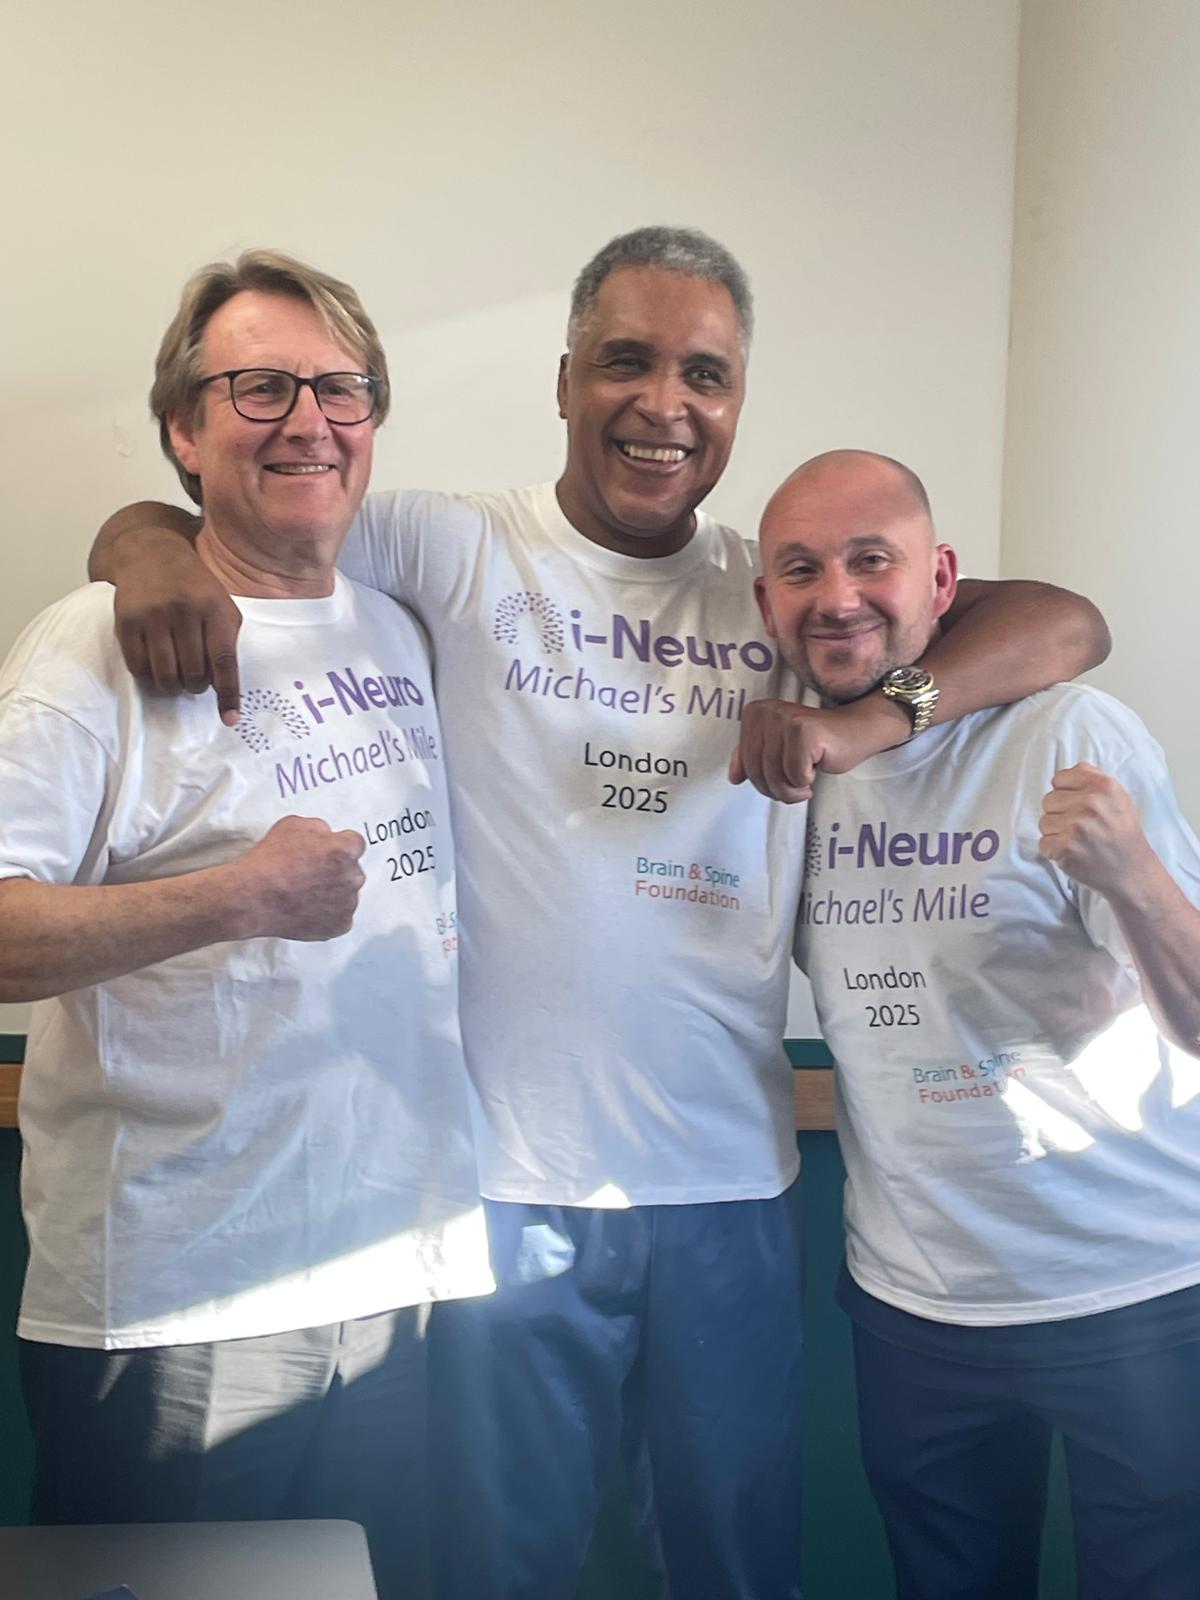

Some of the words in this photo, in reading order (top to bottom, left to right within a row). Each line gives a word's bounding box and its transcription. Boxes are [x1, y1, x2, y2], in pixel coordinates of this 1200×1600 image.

[570, 609, 774, 673] i-Neuro
[294, 667, 424, 724] i-Neuro
[504, 658, 676, 715] Michael's
[687, 684, 746, 721] Mil
[275, 729, 405, 799] Michael's
[584, 742, 688, 778] London
[601, 784, 668, 814] 2025
[364, 807, 436, 845] London
[828, 821, 1000, 869] i-Neuro
[636, 857, 684, 879] Brain
[688, 863, 702, 881] &
[703, 865, 740, 889] Spine
[635, 880, 740, 911] Foundation
[798, 888, 904, 925] ichael's
[912, 884, 991, 922] Mile
[843, 966, 927, 990] London
[865, 1004, 921, 1028] 2025
[912, 1067, 957, 1084] Brain
[960, 1064, 976, 1080] &
[918, 1067, 1026, 1104] Foundatn
